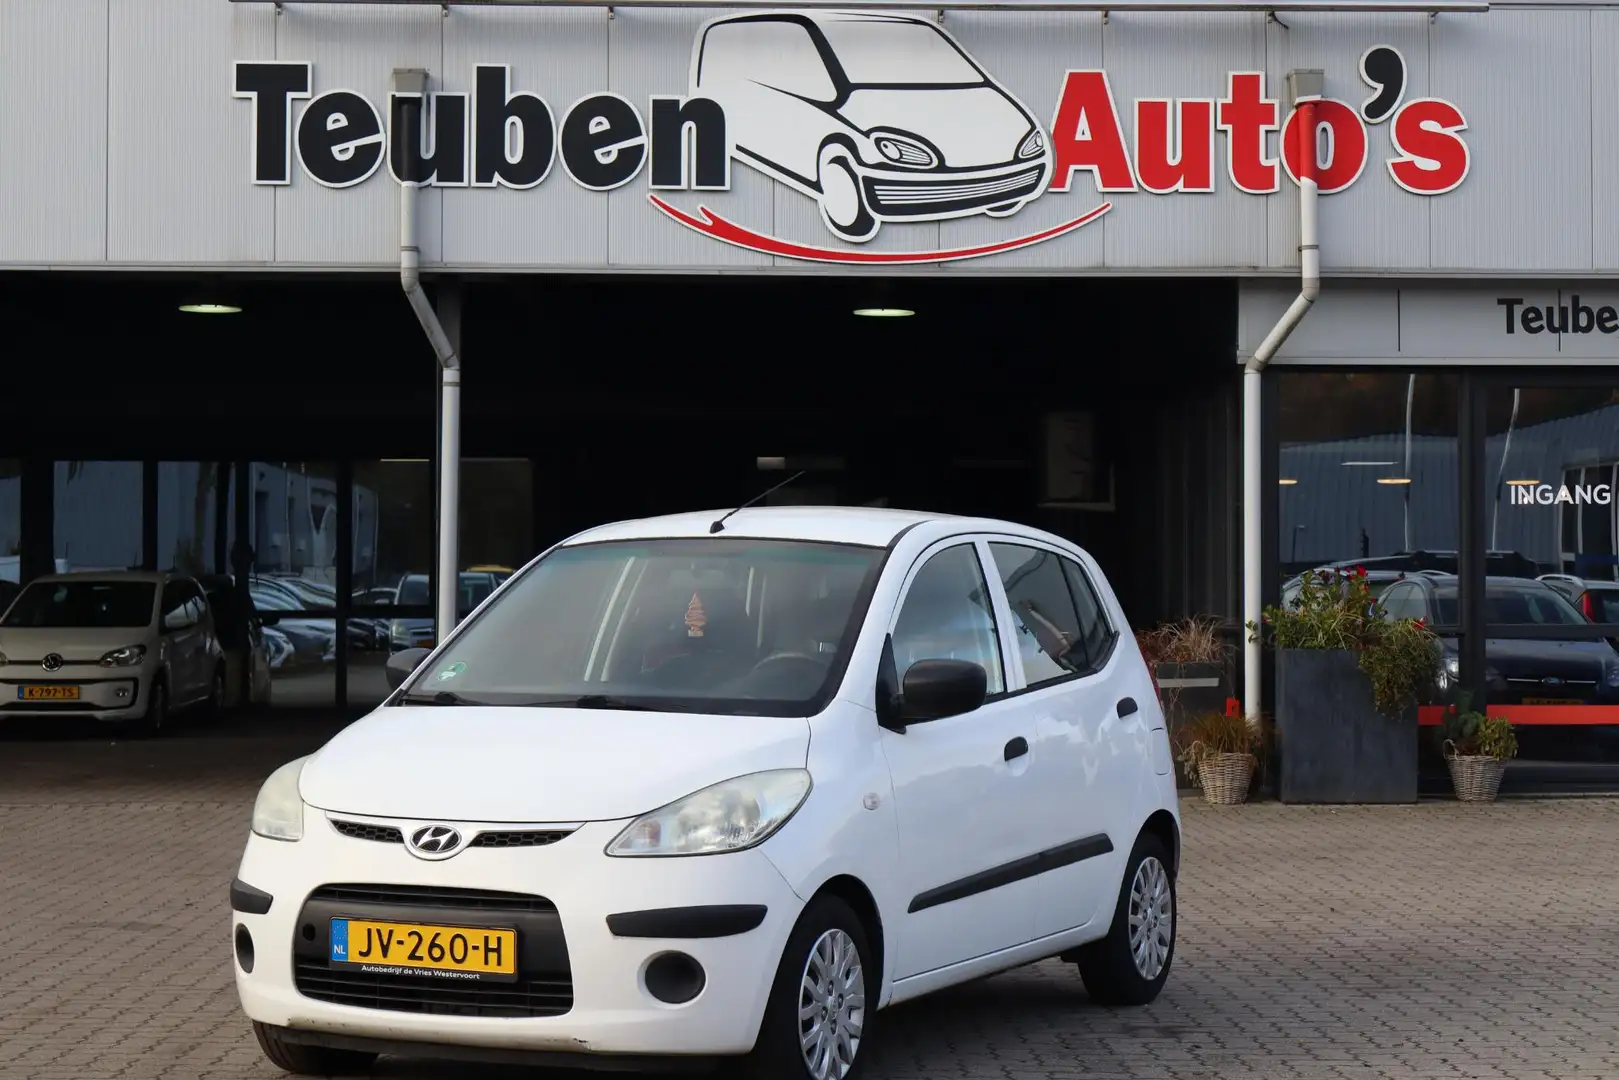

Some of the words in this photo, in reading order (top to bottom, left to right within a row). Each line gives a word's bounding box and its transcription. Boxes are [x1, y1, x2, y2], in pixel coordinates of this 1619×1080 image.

[232, 60, 731, 191] Teuben
[1048, 44, 1471, 195] Auto's
[1497, 294, 1619, 334] Teube
[1510, 484, 1611, 505] INGANG
[333, 944, 346, 955] NL
[358, 927, 502, 967] JV-260-H
[361, 964, 403, 975] Autobedrijf
[413, 968, 432, 977] Vries
[433, 970, 481, 980] Westervoort
